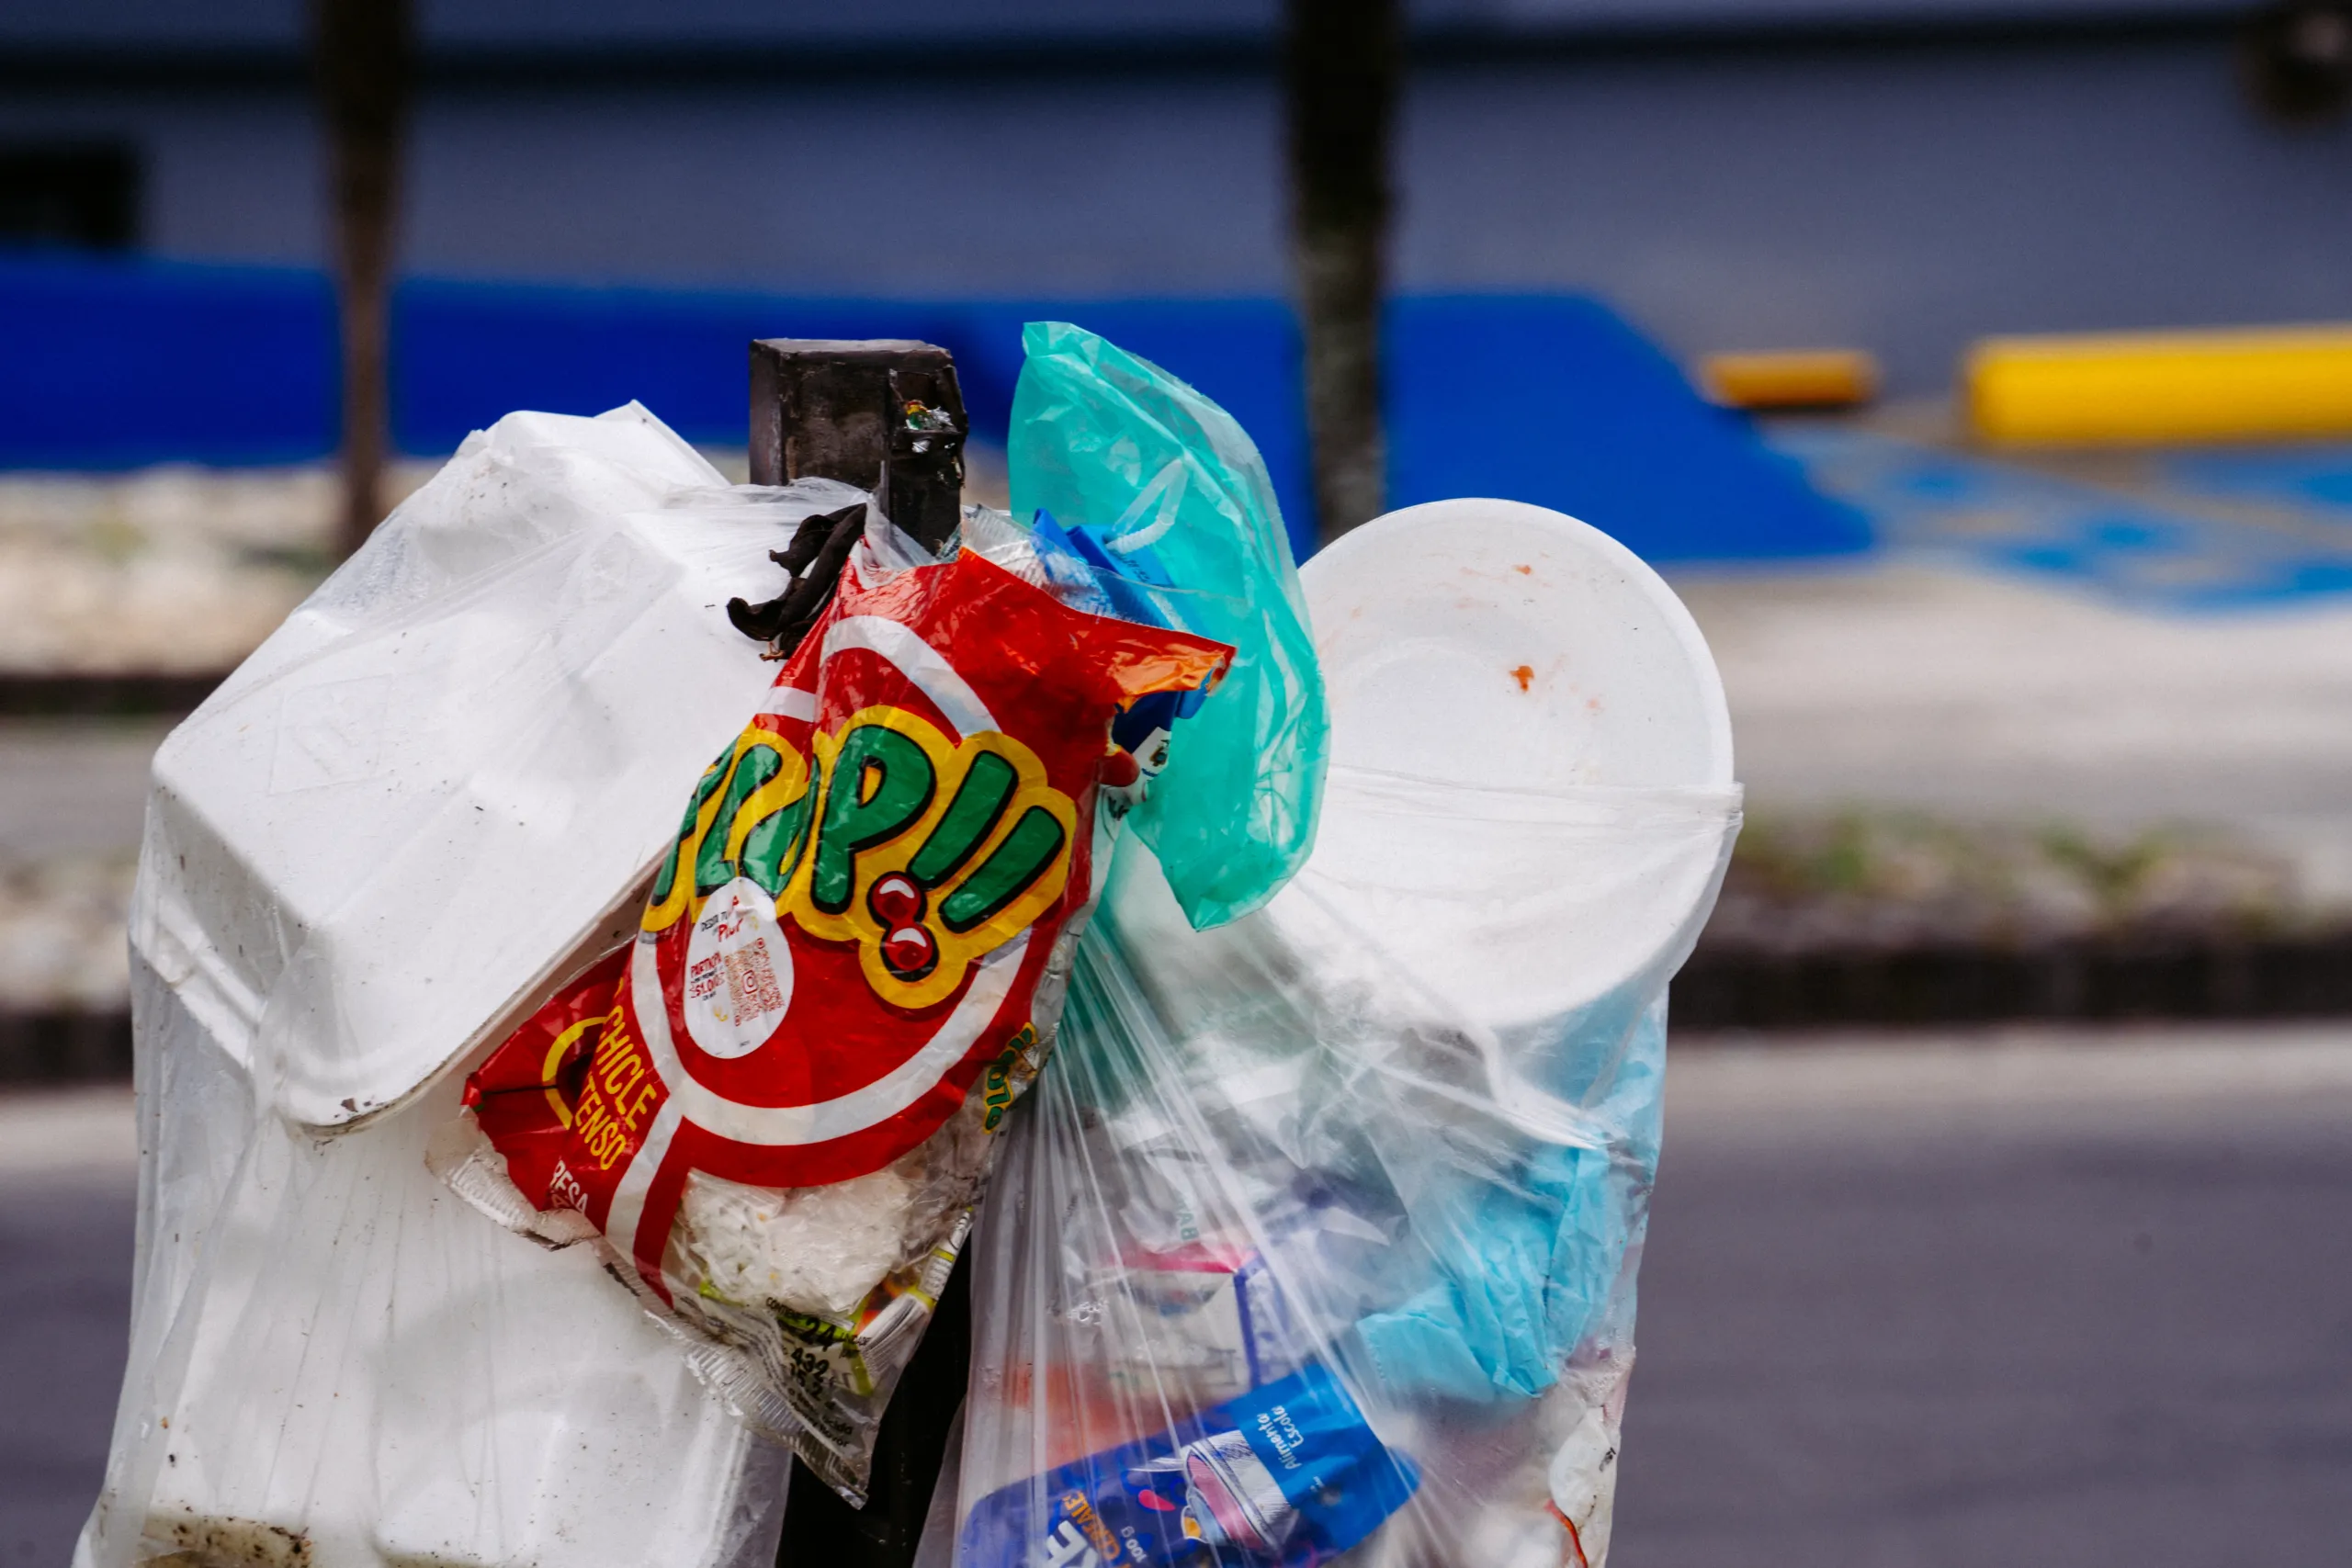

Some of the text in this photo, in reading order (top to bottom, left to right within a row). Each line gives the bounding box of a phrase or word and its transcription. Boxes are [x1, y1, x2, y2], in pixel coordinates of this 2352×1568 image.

[596, 1005, 657, 1132] CHICLE
[575, 1070, 628, 1170] TENSO
[550, 1155, 588, 1214] RESA
[801, 1316, 837, 1352] 24
[790, 1348, 830, 1382] 432
[1120, 1525, 1148, 1563] 100 g
